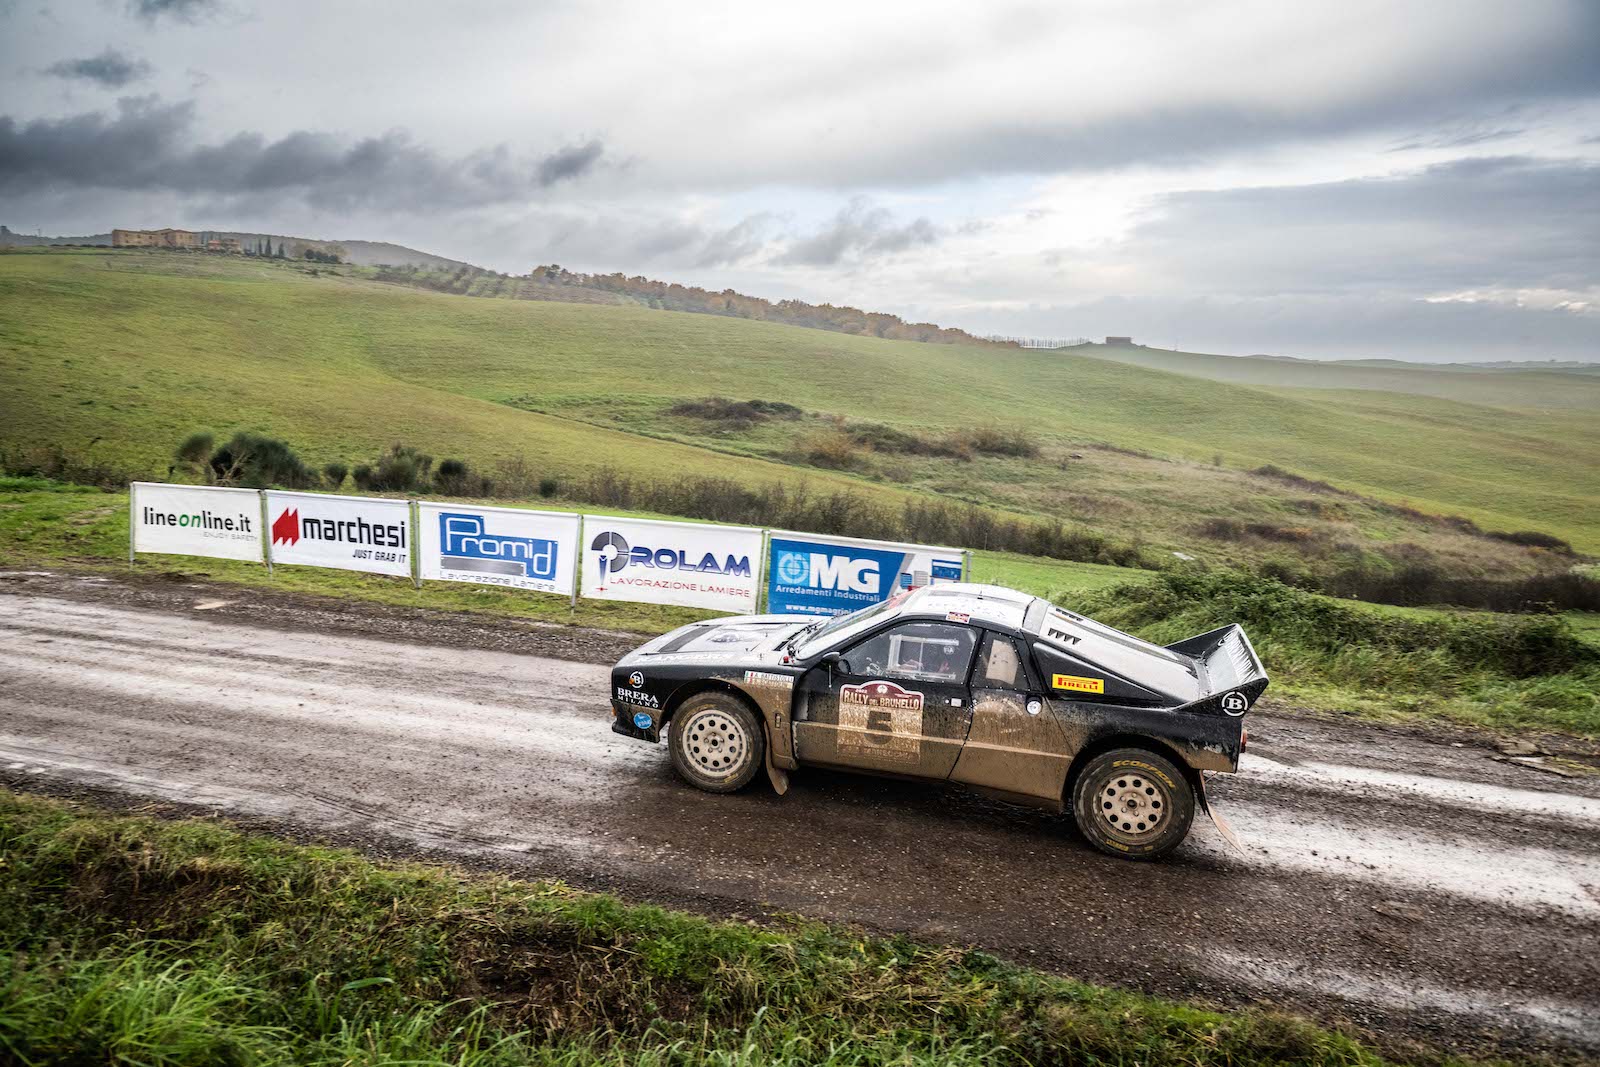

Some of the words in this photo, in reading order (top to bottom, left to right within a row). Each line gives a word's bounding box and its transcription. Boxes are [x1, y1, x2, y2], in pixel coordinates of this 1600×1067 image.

[143, 506, 251, 533] lineonline.it
[302, 517, 406, 549] marchesi
[352, 549, 373, 560] JUST
[374, 551, 396, 563] GRAB
[398, 554, 407, 564] IT
[445, 517, 553, 576] Promid
[440, 573, 511, 584] Lavorazione
[514, 578, 556, 591] Lamiere
[809, 552, 880, 593] MG
[610, 576, 697, 591] LAVORAZIONE
[700, 584, 750, 598] LAMIERE
[775, 584, 832, 597] Arredamenti
[834, 590, 880, 603] Industriali
[1057, 677, 1098, 690] PIRELLI
[617, 687, 659, 704] BRERA
[617, 695, 659, 709] MILANO
[844, 690, 869, 705] RALLY
[880, 697, 920, 711] BRUNELLO
[864, 710, 894, 746] 5
[1112, 760, 1176, 789] SCORPION
